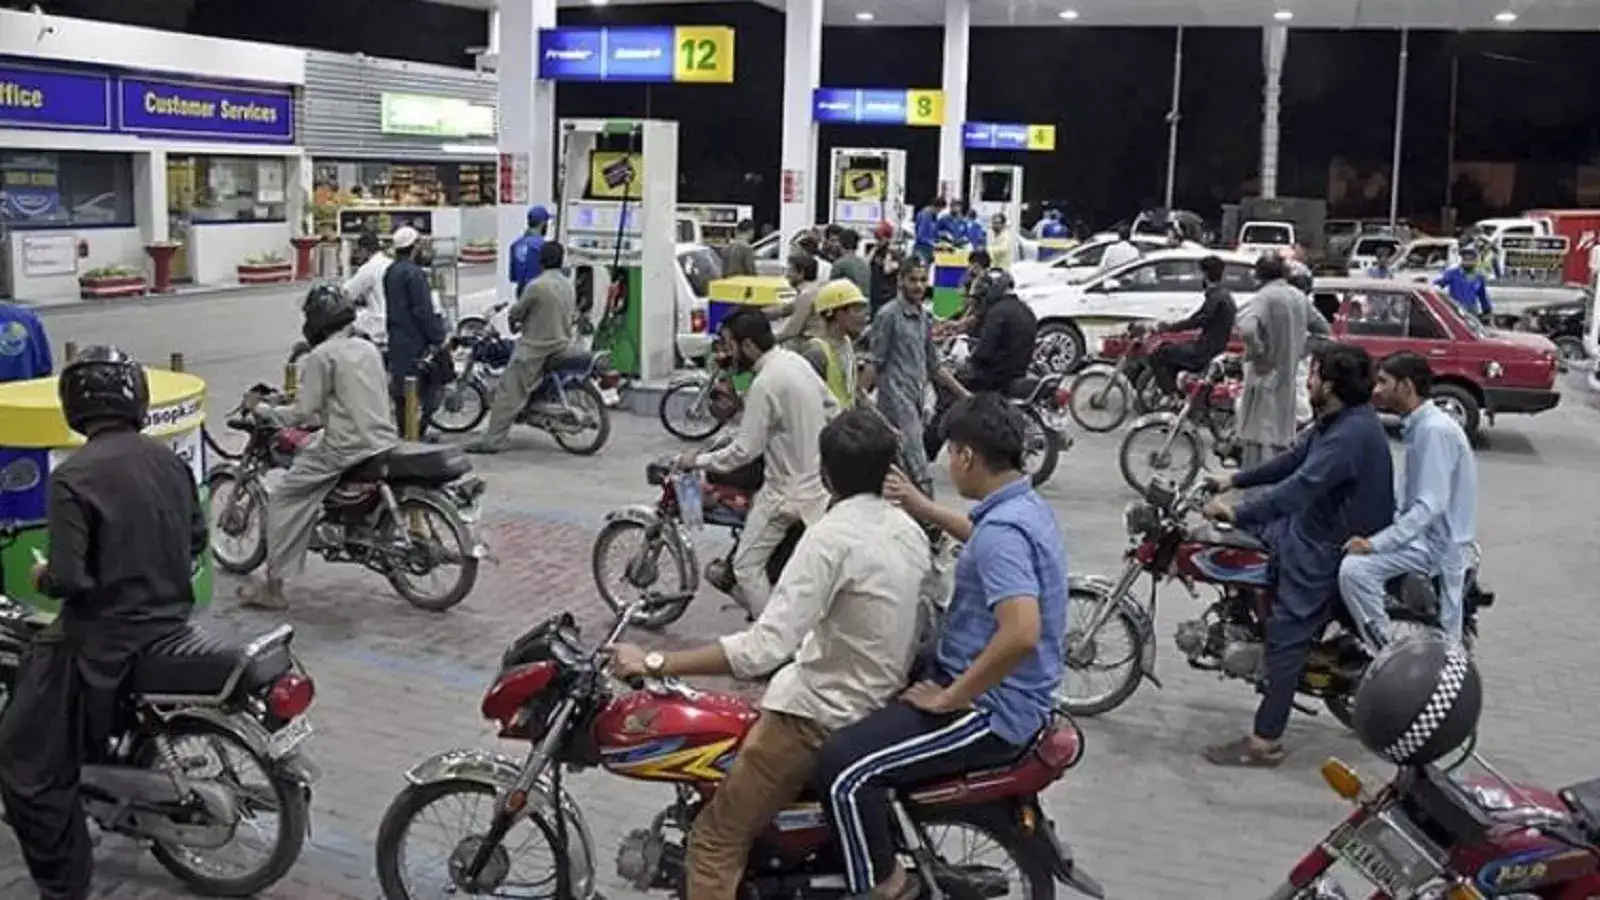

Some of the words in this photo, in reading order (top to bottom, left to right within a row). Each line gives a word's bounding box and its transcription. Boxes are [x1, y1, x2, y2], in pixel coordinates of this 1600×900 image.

[681, 39, 717, 70] 12
[144, 91, 216, 117] Customer
[220, 99, 277, 122] Services
[917, 96, 932, 118] 8
